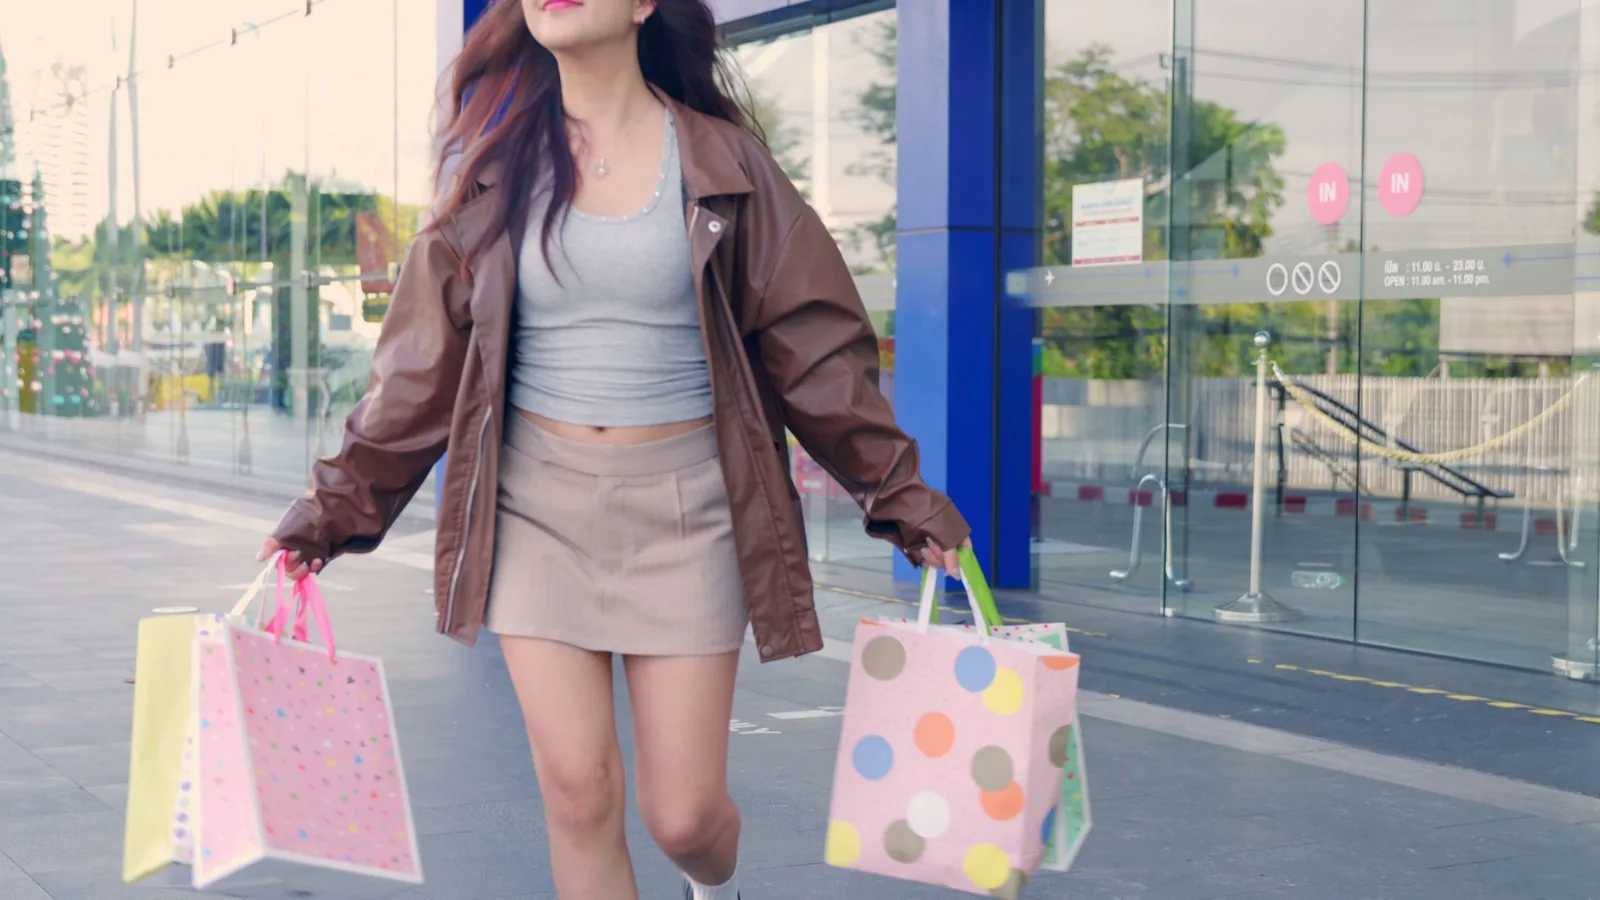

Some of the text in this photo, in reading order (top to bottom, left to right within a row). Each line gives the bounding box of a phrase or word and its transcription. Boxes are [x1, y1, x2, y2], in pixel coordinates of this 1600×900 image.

[1319, 181, 1336, 203] IN
[1390, 172, 1410, 194] IN
[1411, 261, 1433, 273] 11.00
[1453, 259, 1476, 272] 23.00
[1384, 275, 1405, 287] OPEN
[1411, 275, 1431, 286] 11.00
[1453, 274, 1474, 285] 11.00
